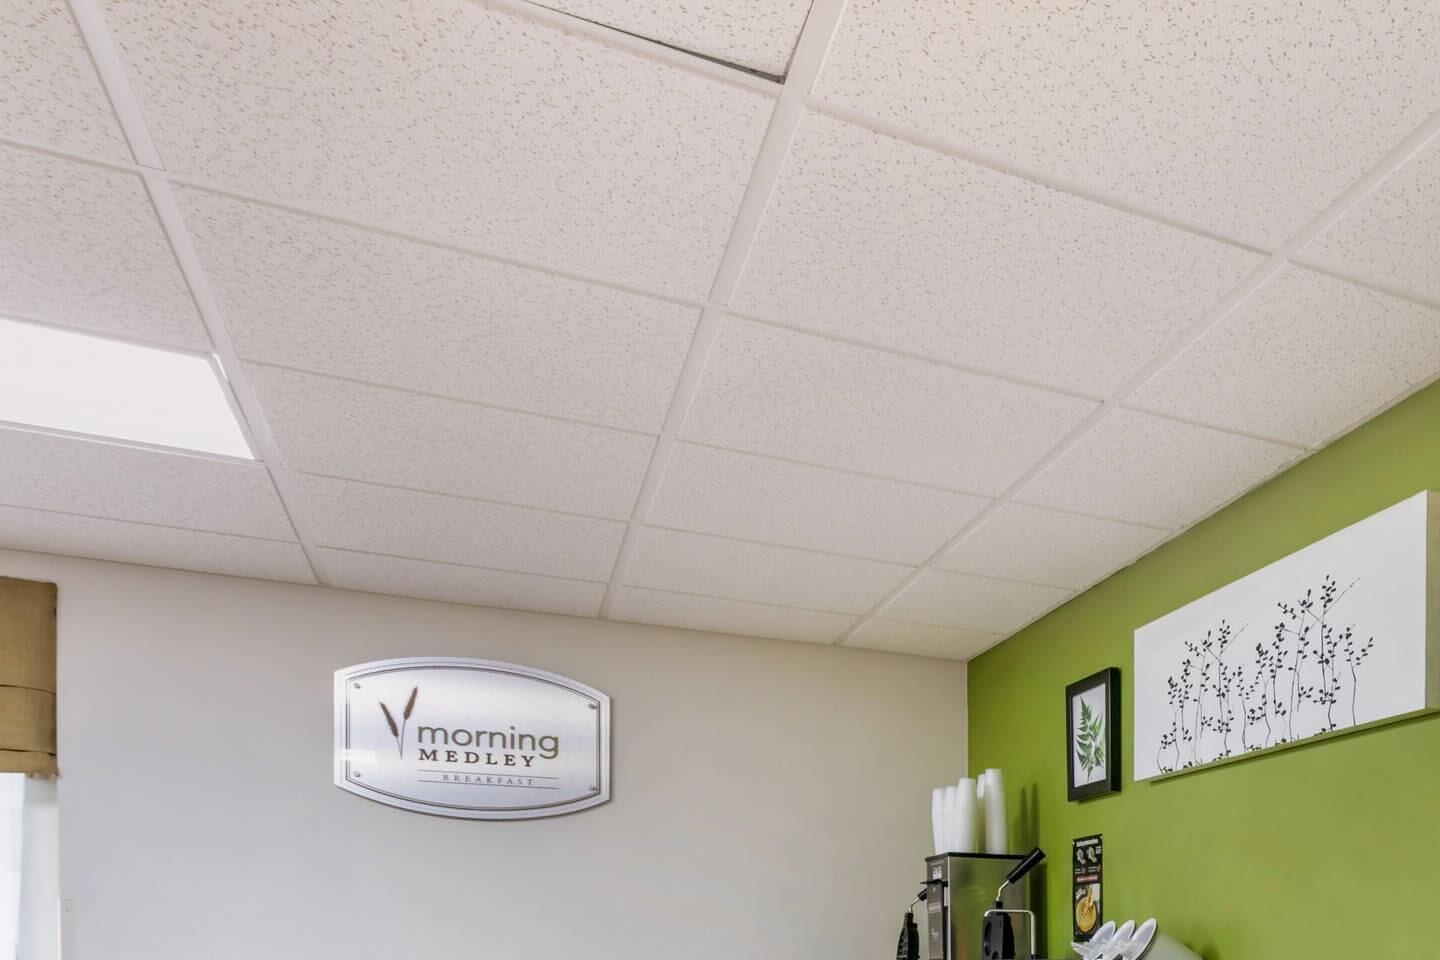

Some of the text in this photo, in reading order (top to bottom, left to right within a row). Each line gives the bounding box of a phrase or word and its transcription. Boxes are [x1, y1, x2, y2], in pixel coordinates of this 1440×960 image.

[417, 725, 559, 760] morning
[418, 748, 536, 768] MEDLEY
[442, 774, 533, 786] BREAKFAST
